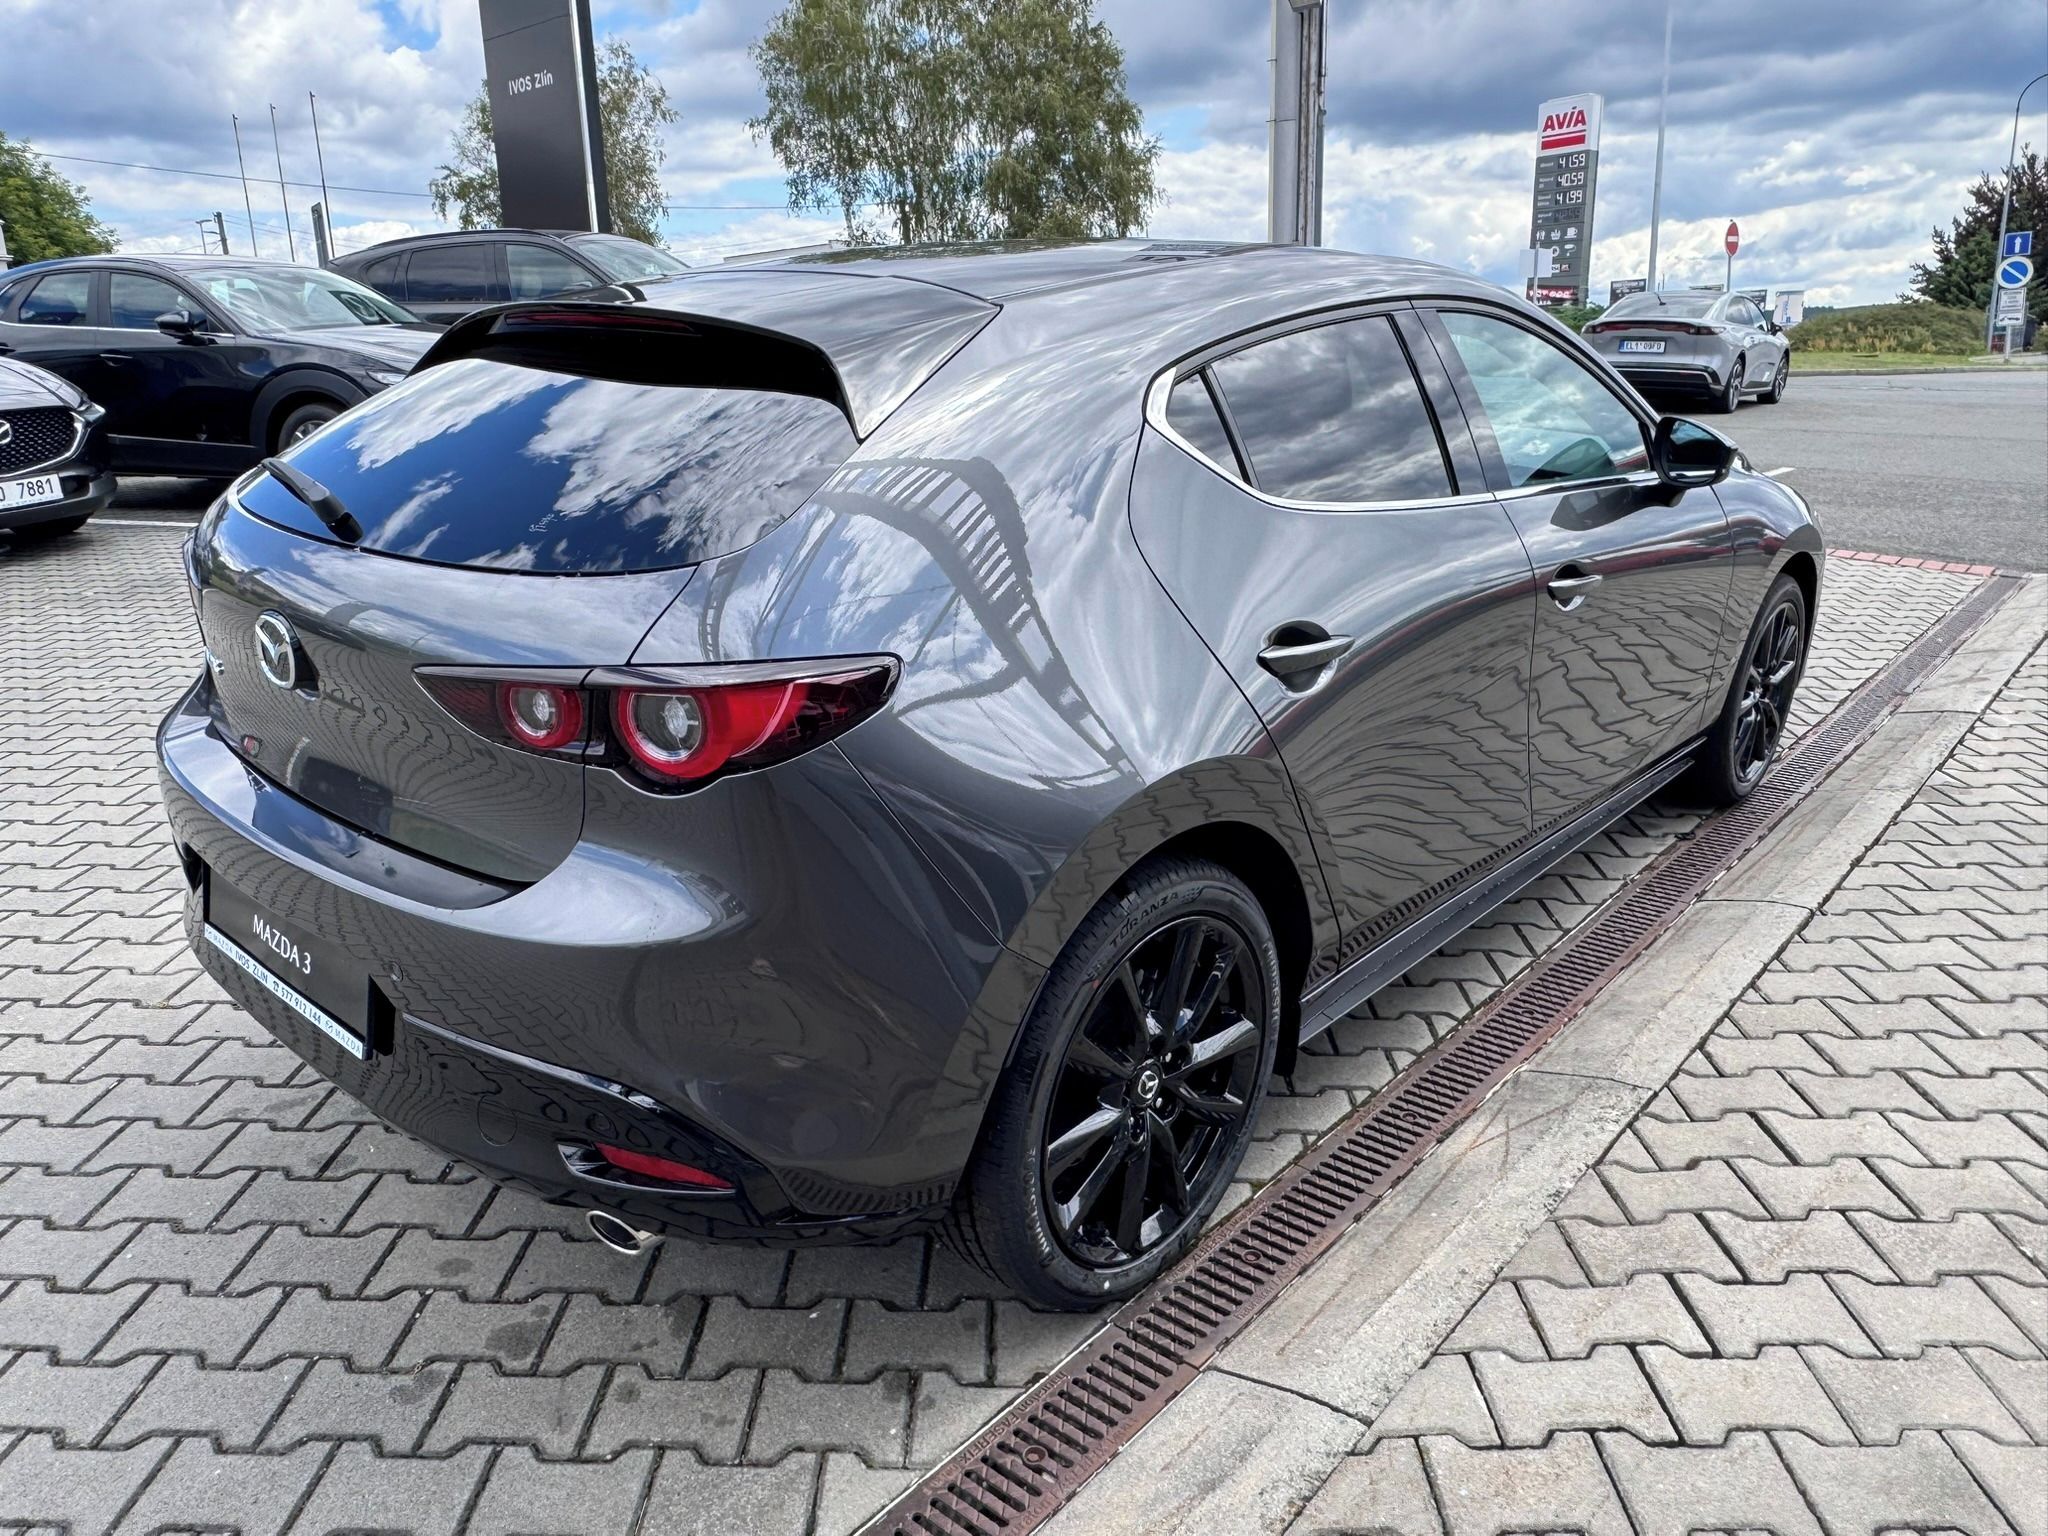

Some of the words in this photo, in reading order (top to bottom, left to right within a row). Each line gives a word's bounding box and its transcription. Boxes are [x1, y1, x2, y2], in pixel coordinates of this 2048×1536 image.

[509, 75, 532, 95] IVOS
[534, 69, 553, 88] Zlín
[1542, 106, 1586, 132] AVIA
[16, 478, 54, 499] 7881
[253, 914, 299, 968] MAZDA
[302, 952, 311, 974] 3
[1109, 892, 1179, 948] TURANZA
[281, 987, 293, 1002] 577
[294, 997, 307, 1014] 912
[309, 1008, 321, 1025] 144
[335, 1028, 361, 1053] MAZDA
[957, 1410, 1020, 1464] FASERFIX
